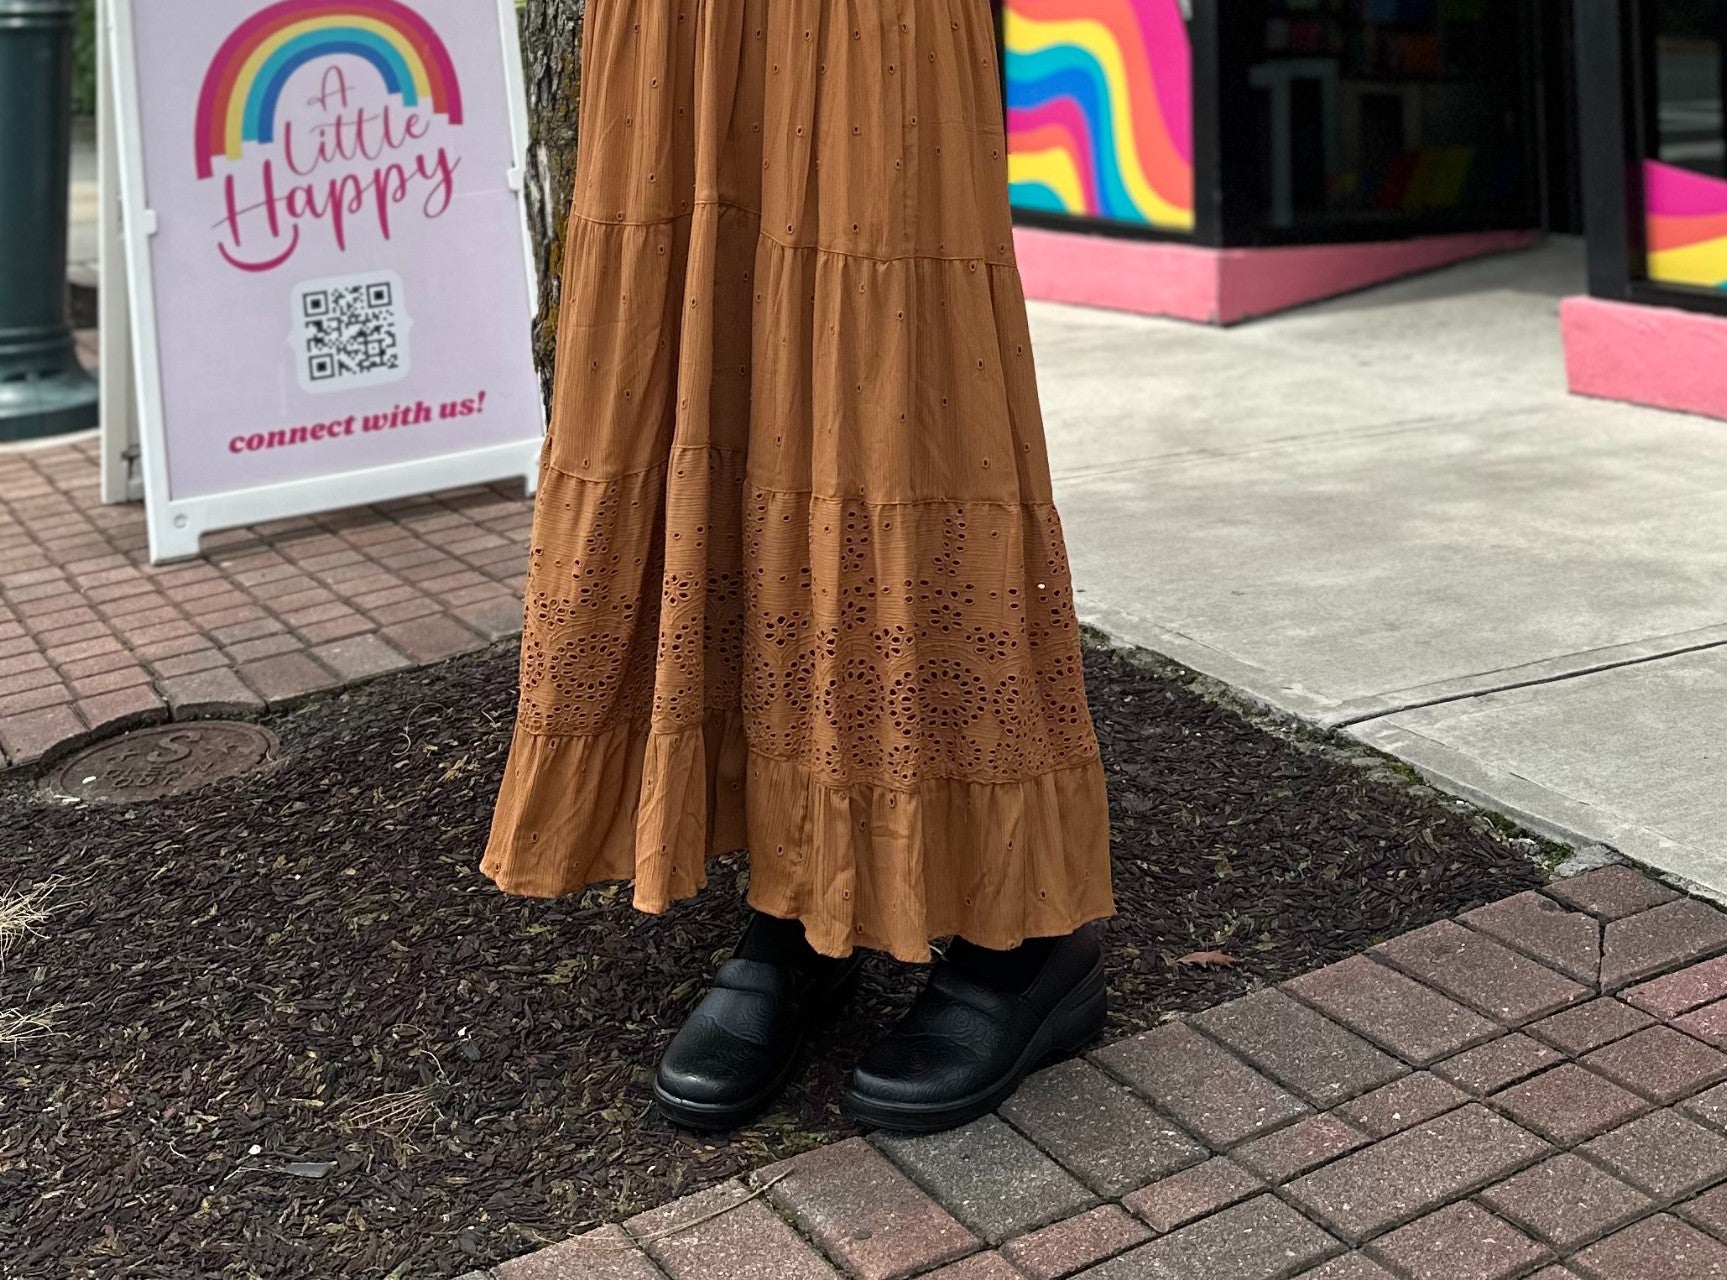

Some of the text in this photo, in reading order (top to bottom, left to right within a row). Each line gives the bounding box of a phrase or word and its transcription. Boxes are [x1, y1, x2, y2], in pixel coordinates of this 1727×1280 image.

[307, 64, 356, 111] A
[284, 105, 429, 175] Little
[211, 147, 461, 252] Happy
[228, 390, 486, 454] connect with us!
